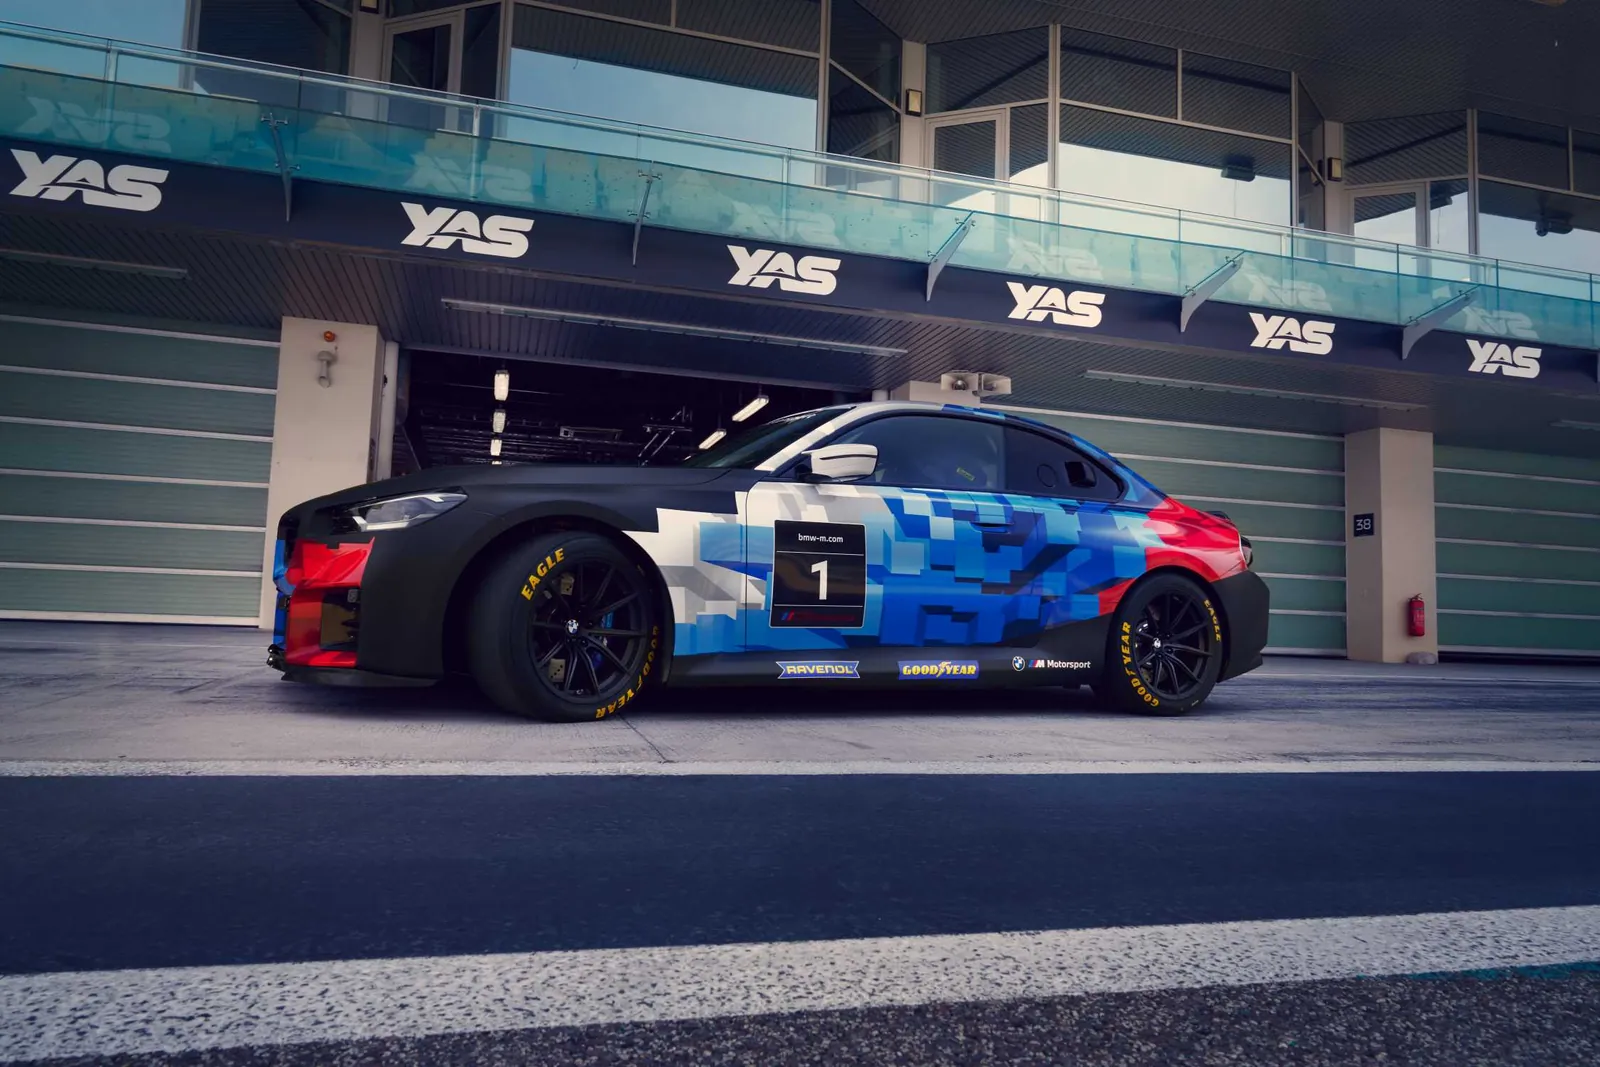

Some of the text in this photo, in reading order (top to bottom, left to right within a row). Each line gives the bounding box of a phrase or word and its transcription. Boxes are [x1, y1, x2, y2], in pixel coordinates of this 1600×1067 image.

[9, 148, 169, 212] YAS
[400, 202, 535, 258] YAS
[726, 244, 841, 295] YAS
[1006, 281, 1106, 328] YAS
[1248, 312, 1336, 355] YAS
[1466, 339, 1542, 379] YAS
[798, 533, 844, 543] bmw-m.com
[1356, 518, 1371, 531] 38
[521, 548, 565, 601] EAGLE
[811, 560, 828, 600] 1
[1203, 599, 1222, 642] EAGLE
[786, 665, 854, 675] RAVENOL
[1047, 660, 1091, 670] Motorsport
